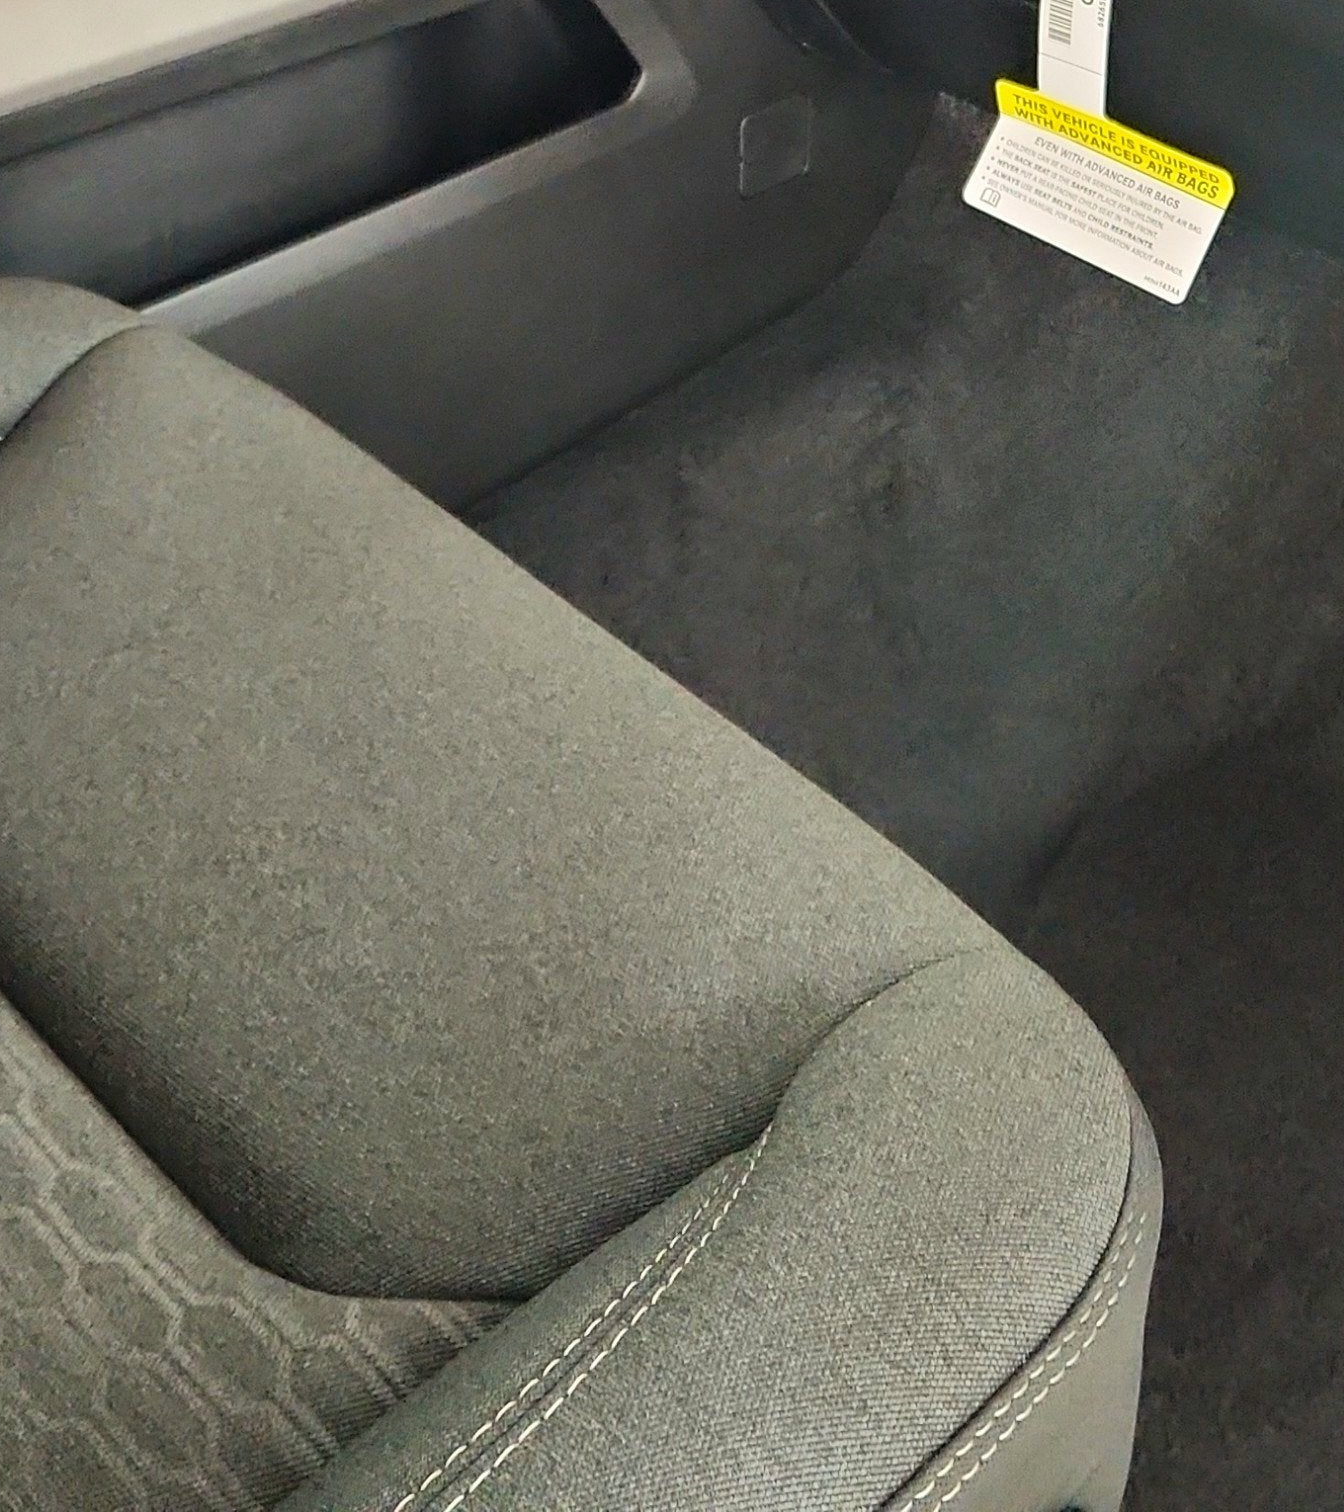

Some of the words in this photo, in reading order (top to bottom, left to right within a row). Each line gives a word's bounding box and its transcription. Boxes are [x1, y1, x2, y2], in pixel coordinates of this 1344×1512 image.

[996, 158, 1019, 173] NEVER
[1013, 93, 1047, 114] THIS
[1052, 108, 1116, 142] VEHICLE
[1121, 137, 1135, 150] IS
[1140, 144, 1220, 184] EQUIPPED
[1015, 106, 1053, 129] WITH
[1059, 125, 1142, 165] ADVANCED
[1146, 160, 1173, 180] AIR
[1177, 171, 1220, 199] BAGS
[991, 168, 1021, 186] ALWAYS
[1033, 187, 1051, 200] SEAT
[1051, 196, 1073, 210] BELTS
[1086, 213, 1110, 228] CHILD
[1005, 138, 1036, 157] CHILDREN
[1059, 163, 1081, 178] KILLED
[1175, 217, 1187, 227] AIR
[1013, 154, 1032, 167] BACK
[1032, 163, 1050, 176] SEAT
[1069, 181, 1096, 197] SAFEST
[1096, 192, 1117, 207] PLACE
[1117, 202, 1131, 213] FOR
[1035, 137, 1057, 152] EVEN
[1060, 148, 1084, 166] WITH
[1085, 160, 1136, 189] ADVANCED
[1137, 183, 1153, 197] AIR
[1155, 191, 1181, 210] BAGS
[1086, 225, 1131, 251] INFORMATION
[1130, 246, 1153, 261] ABOUT
[1152, 256, 1165, 267] AIR
